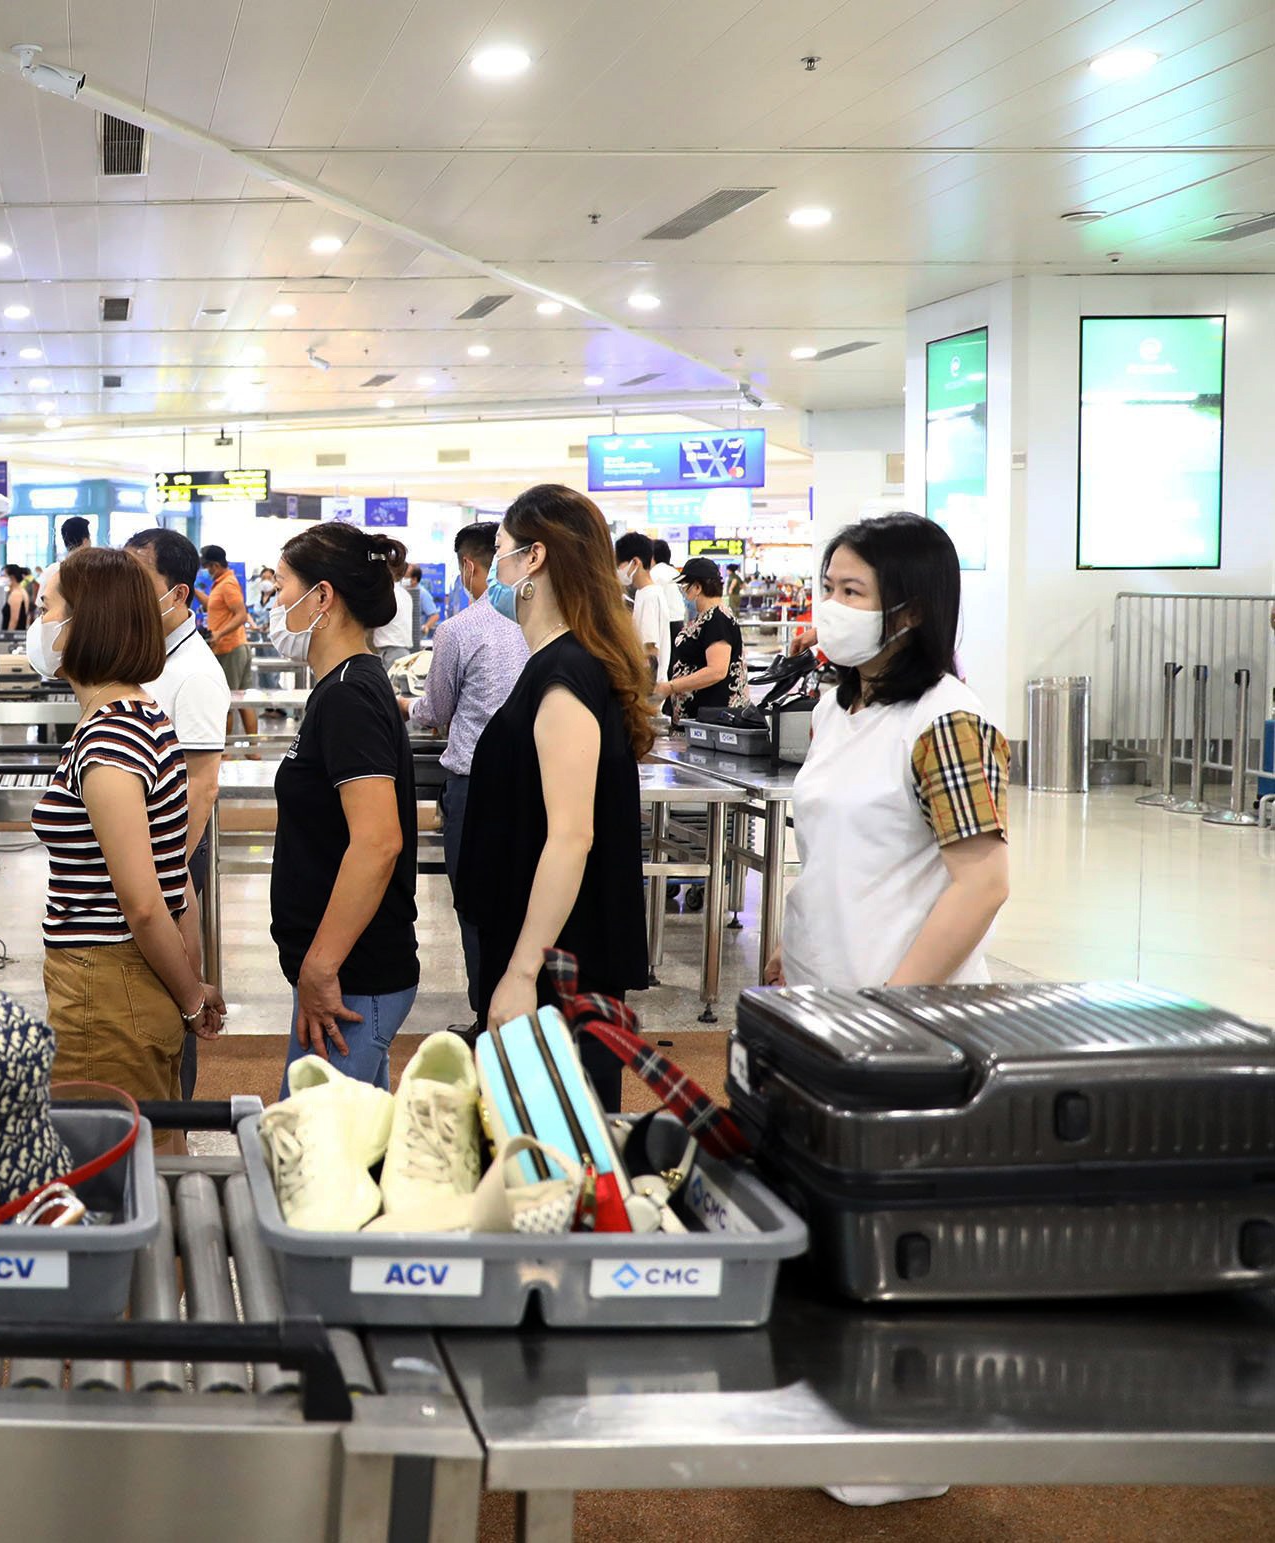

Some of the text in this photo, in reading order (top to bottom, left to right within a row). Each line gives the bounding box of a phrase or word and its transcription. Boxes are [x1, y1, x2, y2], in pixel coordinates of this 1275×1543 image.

[704, 1191, 727, 1230] CMC
[384, 1262, 449, 1286] ACV
[644, 1267, 700, 1285] CMC
